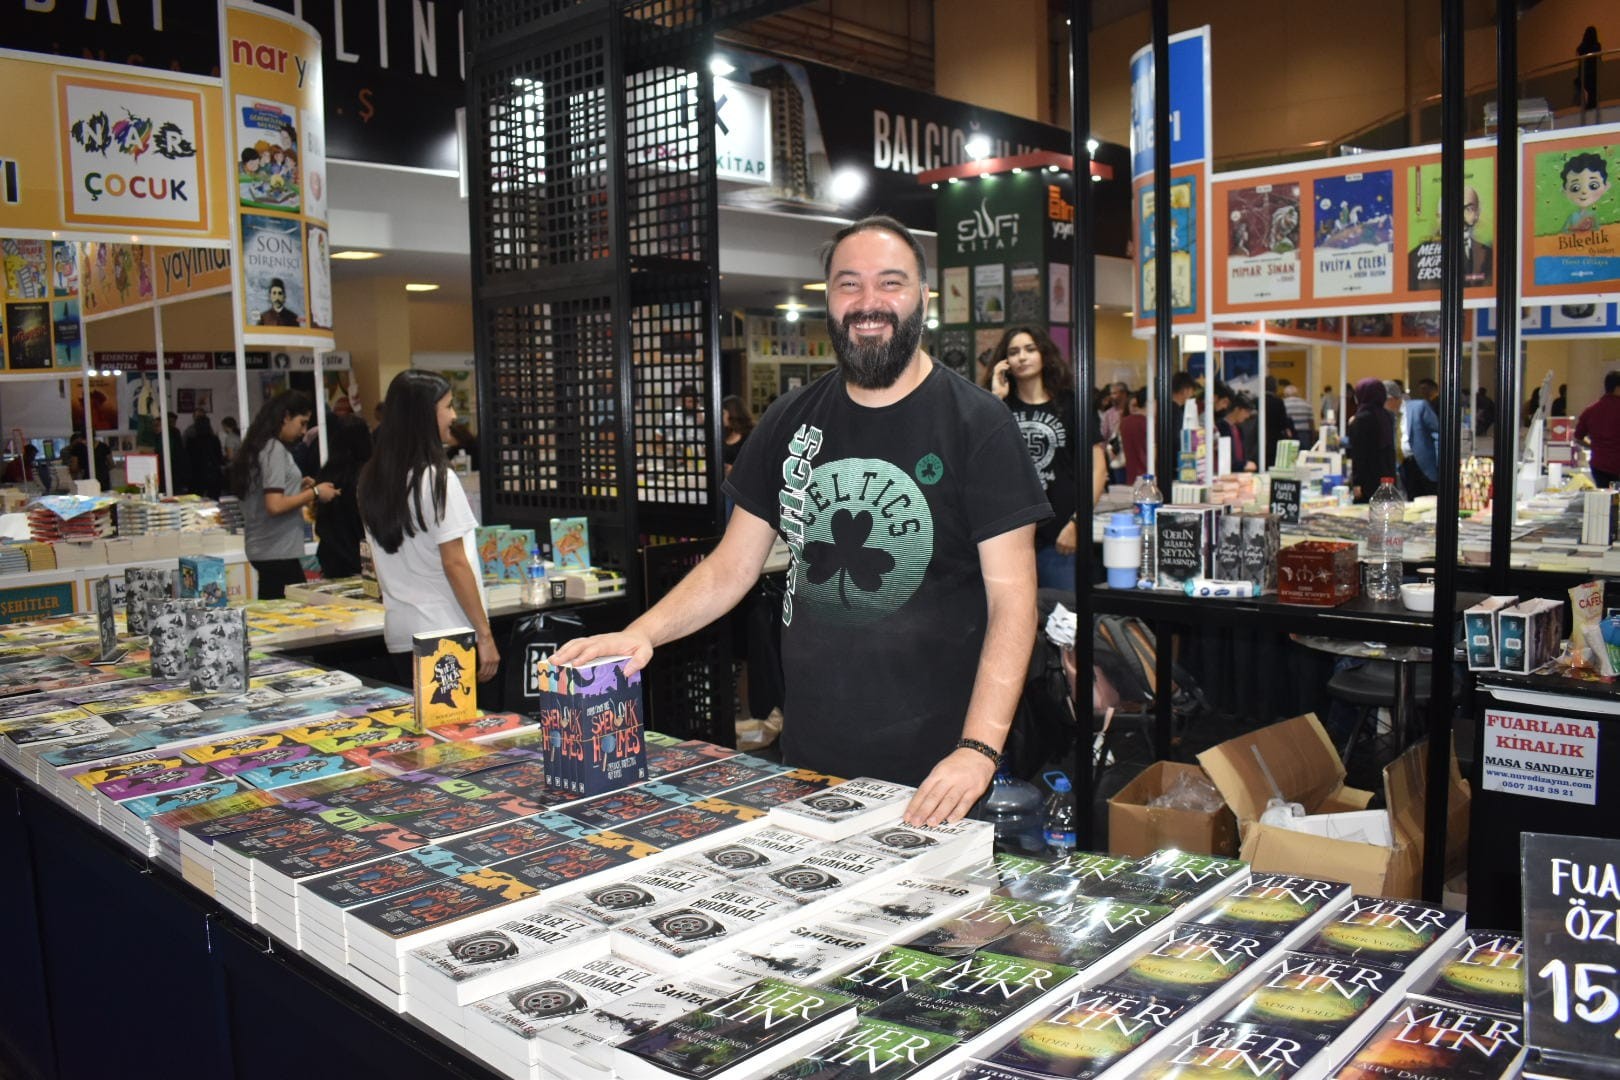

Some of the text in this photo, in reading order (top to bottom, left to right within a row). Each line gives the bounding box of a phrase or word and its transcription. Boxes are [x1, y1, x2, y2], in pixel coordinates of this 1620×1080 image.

[232, 38, 289, 74] nar
[76, 112, 195, 159] NAR
[85, 172, 188, 201] ÇOCUK
[256, 234, 294, 254] SON
[1558, 229, 1609, 250] Bilgelik
[791, 471, 921, 538] CELTICS
[0, 597, 60, 616] ŞEHİTLER
[1487, 713, 1597, 740] FUARLARA
[1496, 733, 1585, 758] KİRALIK
[1485, 756, 1595, 778] MASA SANDALYE
[1502, 780, 1525, 790] 0507
[1528, 784, 1545, 792] 342
[1562, 789, 1574, 797] 21
[802, 856, 875, 875] BIRAKMAZ
[820, 847, 863, 862] GÖLGE
[711, 890, 759, 906] GÖLGE
[897, 879, 969, 897] SAHTEKAR
[1231, 885, 1318, 905] LIN
[1232, 874, 1333, 900] MER
[690, 898, 766, 922] BIRAKMAZ
[1338, 910, 1432, 935] LIN
[1340, 899, 1448, 930] MER
[1564, 898, 1620, 943] ÖZ
[790, 926, 867, 950] SAHTEKAR
[1153, 928, 1261, 959] MER
[1150, 940, 1247, 966] LIN
[556, 968, 637, 997] BIRAKMAZ
[582, 959, 634, 978] GÖLGE
[944, 958, 1053, 992] MER
[1265, 959, 1385, 994] MER
[654, 983, 713, 1006] SAHTEK
[937, 972, 1032, 1000] LIN
[1265, 972, 1368, 1000] LIN
[704, 998, 799, 1030] LIN
[727, 985, 825, 1021] MER
[1053, 990, 1171, 1028] MER
[1047, 1006, 1151, 1037] LIN
[1389, 1006, 1525, 1048] MER
[818, 1025, 931, 1065] MER
[1172, 1029, 1301, 1069] MER
[1392, 1021, 1506, 1057] LIN
[803, 1040, 904, 1074] LIN
[1170, 1045, 1283, 1077] LIN
